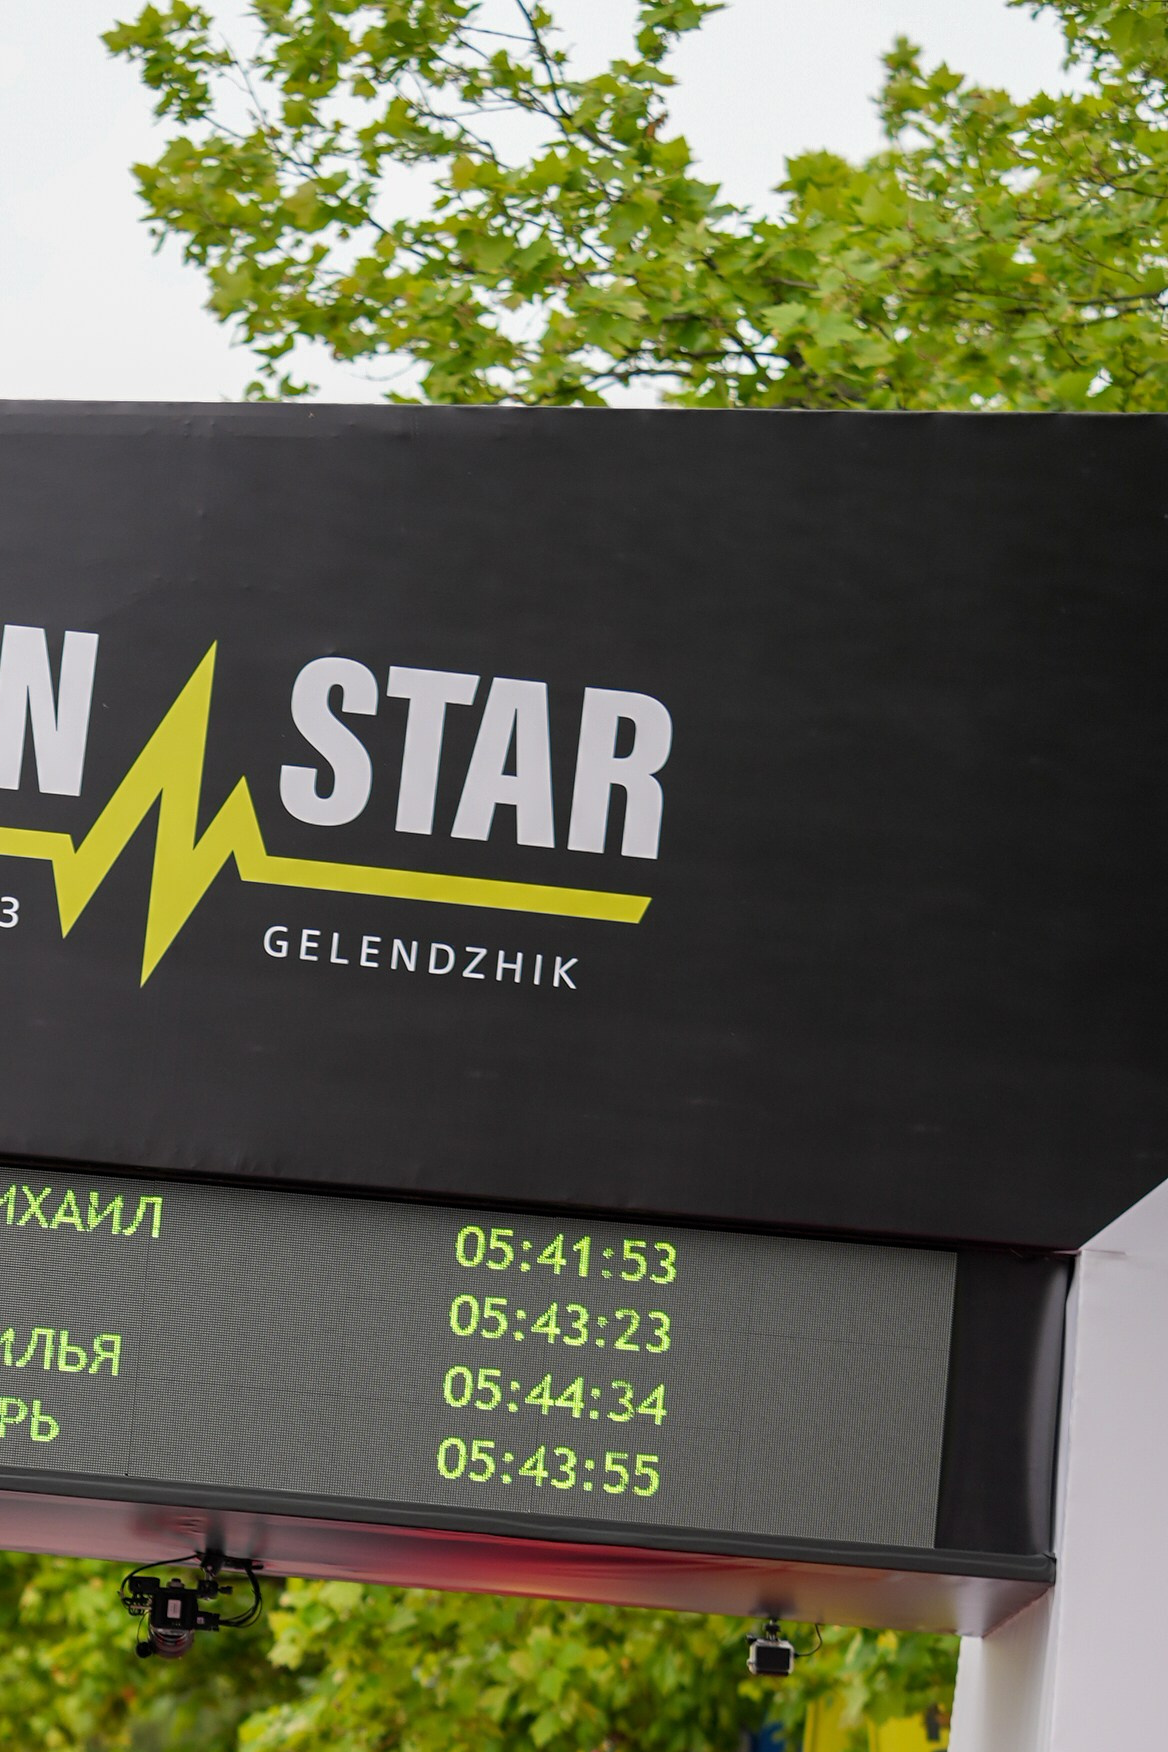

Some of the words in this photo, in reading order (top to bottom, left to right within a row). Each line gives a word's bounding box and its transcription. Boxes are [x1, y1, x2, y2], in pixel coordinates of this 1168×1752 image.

[279, 658, 672, 860] STAR
[263, 925, 580, 990] GELENDZHIK
[455, 1225, 678, 1284] 05:41:53
[449, 1293, 672, 1353] 05:43:23
[442, 1364, 668, 1425] 05:44:34
[436, 1436, 661, 1497] 05:43:55
